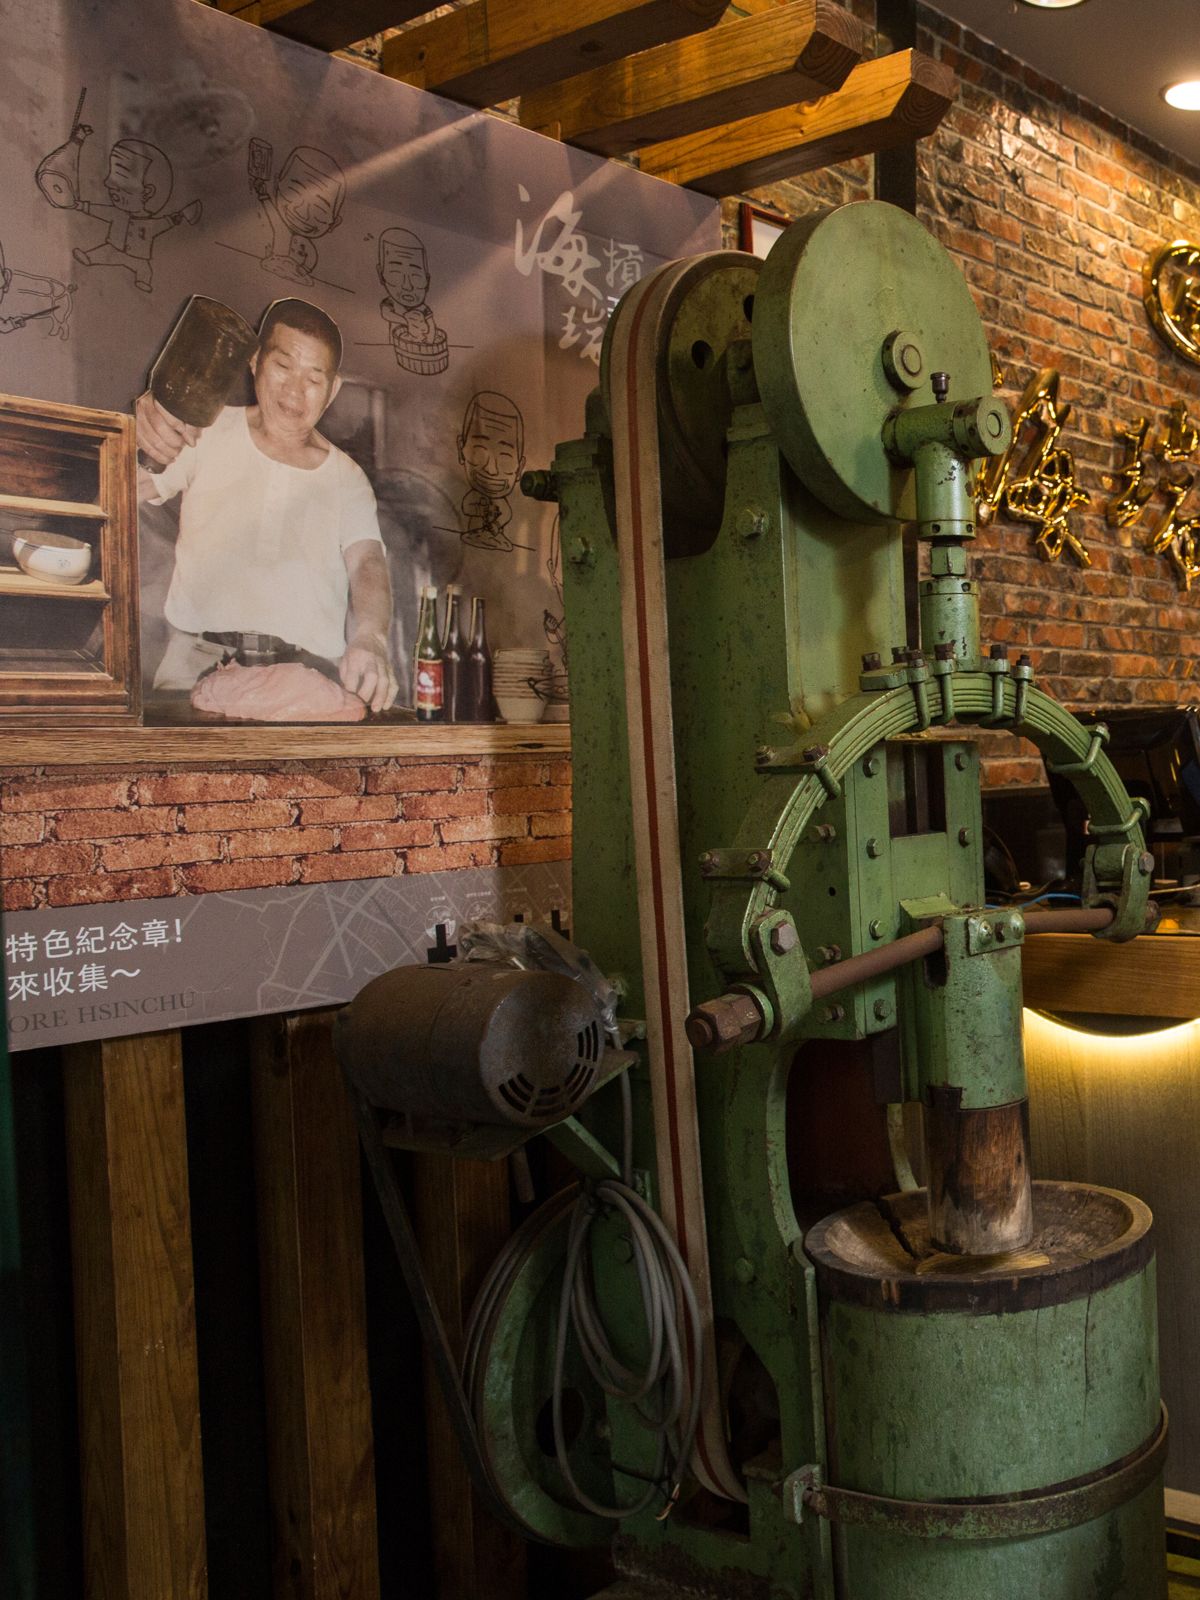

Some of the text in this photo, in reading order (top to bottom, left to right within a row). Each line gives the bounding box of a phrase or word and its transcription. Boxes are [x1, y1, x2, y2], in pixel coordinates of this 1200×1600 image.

[5, 918, 182, 963] 特色紀念章!
[78, 991, 196, 1024] HSINCHU
